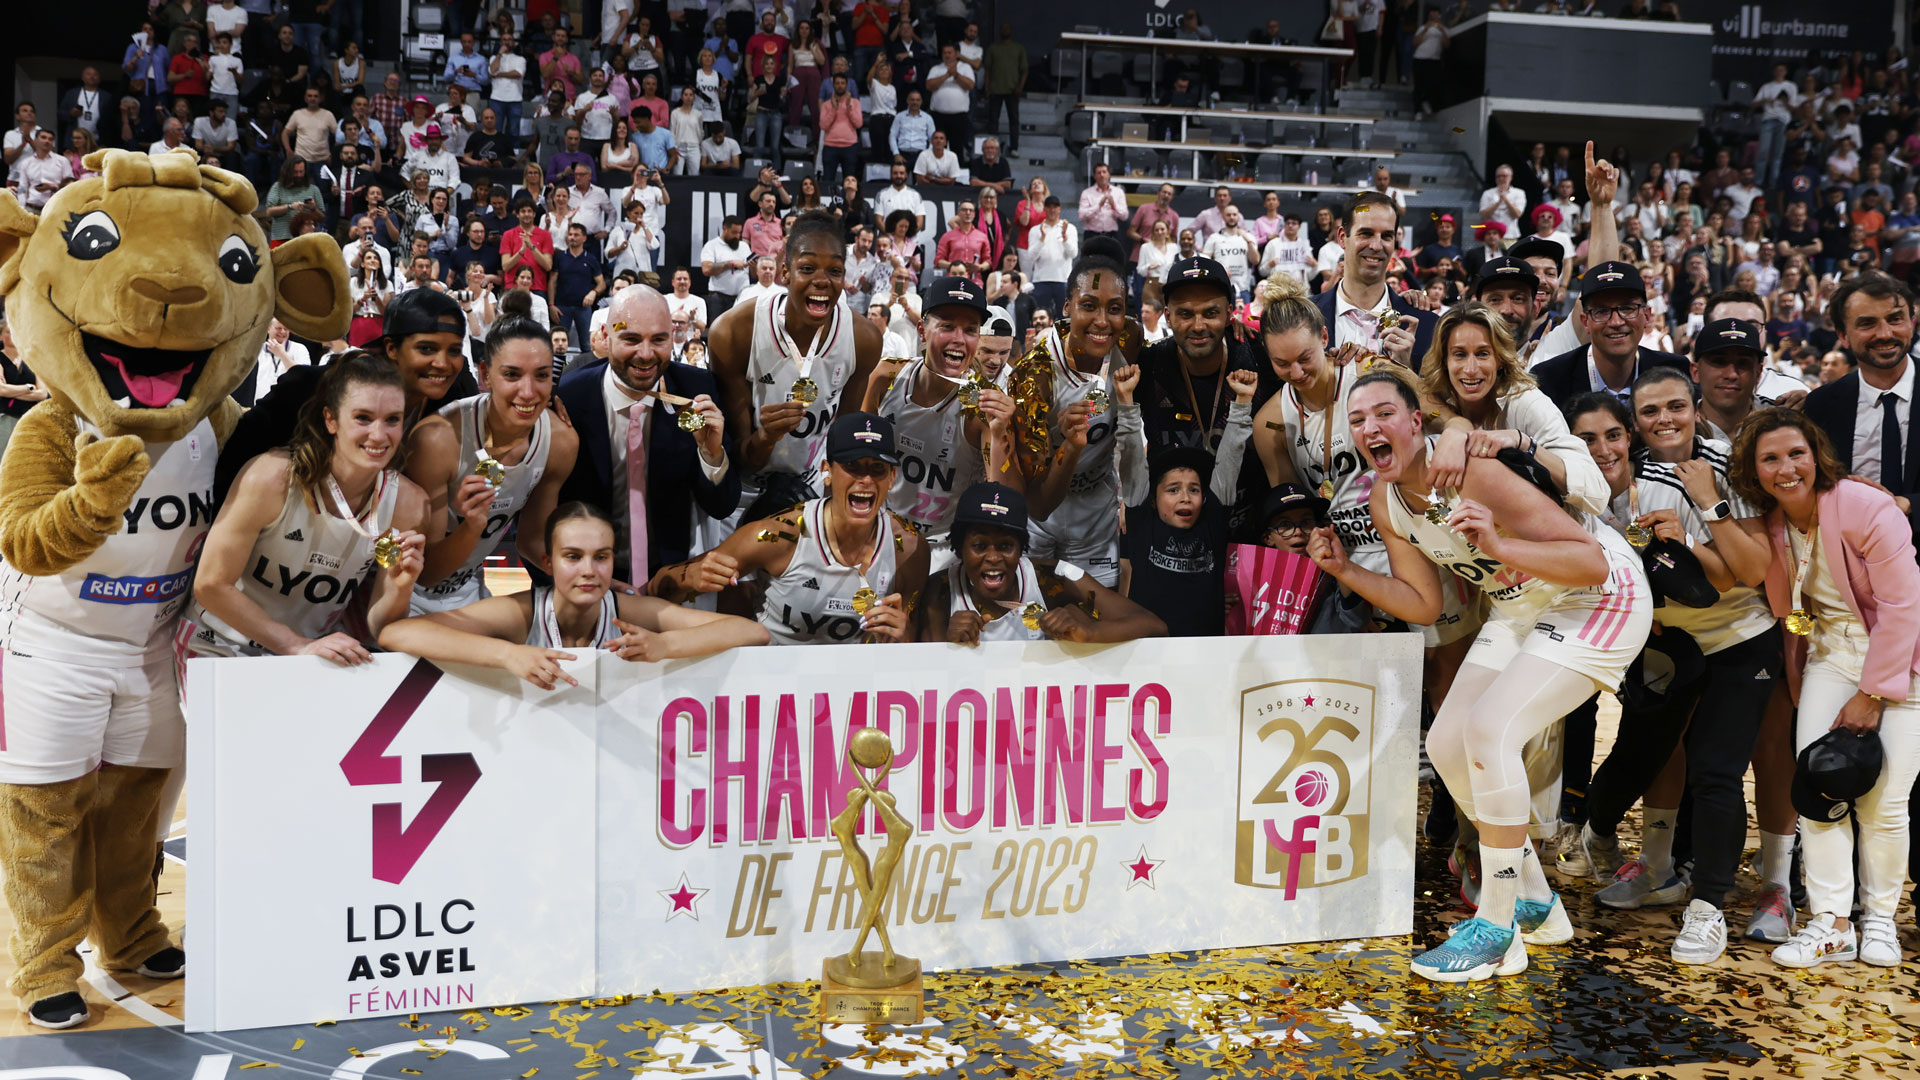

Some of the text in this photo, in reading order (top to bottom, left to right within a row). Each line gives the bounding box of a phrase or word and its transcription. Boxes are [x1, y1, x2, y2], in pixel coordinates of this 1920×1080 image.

[1722, 5, 1848, 38] villeurbanne
[1221, 248, 1246, 256] LYON
[123, 490, 212, 534] YON
[908, 492, 950, 520] 22
[320, 560, 340, 569] LYON
[90, 580, 141, 598] RENT
[160, 575, 187, 595] CAR
[1273, 609, 1300, 626] ASVE
[1257, 697, 1360, 716] 1998 2023
[656, 682, 1172, 850] CHAMPIONNES
[726, 852, 793, 938] DE
[981, 834, 1098, 920] 2023
[347, 898, 476, 943] LDLC
[347, 947, 476, 982] ASVEL
[349, 983, 475, 1014] FÉMININ
